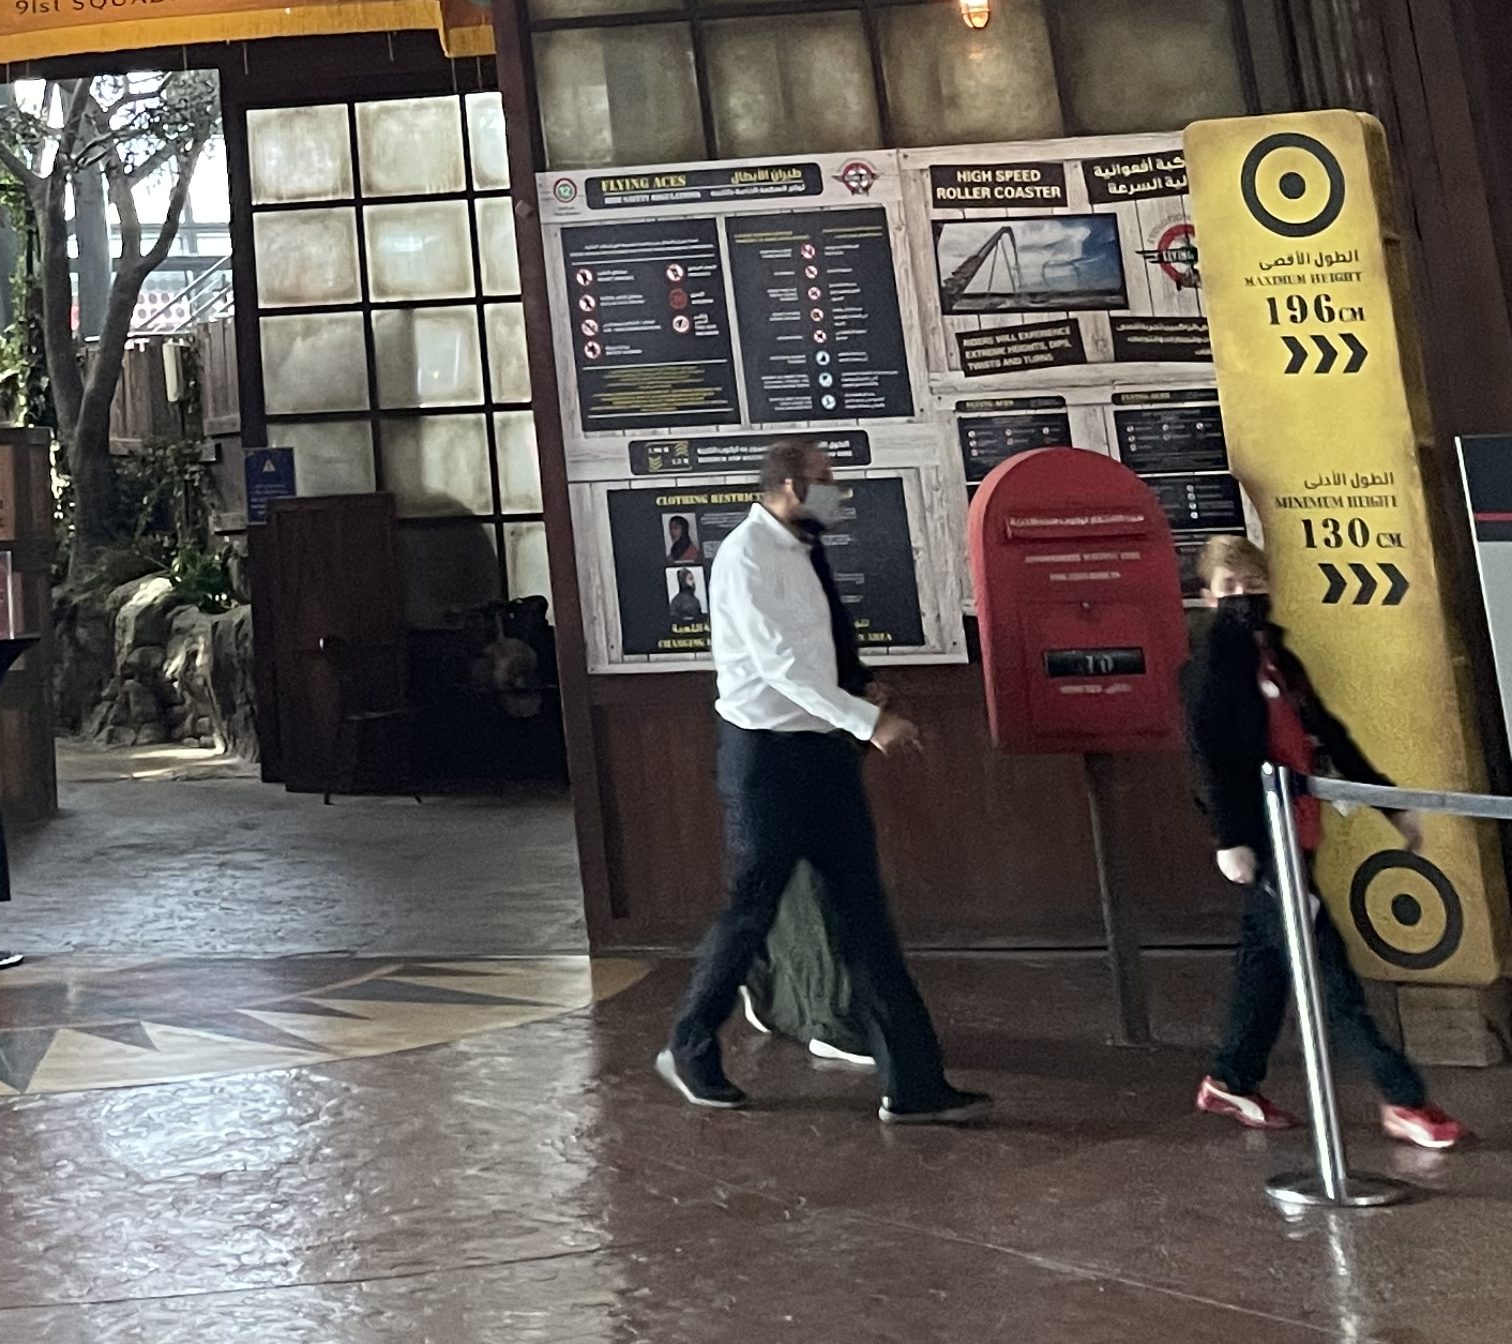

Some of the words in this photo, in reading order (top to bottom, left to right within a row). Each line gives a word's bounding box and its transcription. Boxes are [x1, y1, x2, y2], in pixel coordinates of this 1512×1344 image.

[601, 177, 649, 192] FLYING
[653, 175, 686, 188] ACES
[957, 169, 992, 182] HIGH
[995, 168, 1041, 182] SPEED
[936, 186, 990, 200] ROLLER
[993, 185, 1061, 199] COASTER
[1108, 177, 1163, 195] السرعة
[1259, 250, 1311, 271] الأقصى
[1314, 249, 1359, 267] الطول
[1245, 274, 1306, 287] MAXIMUM
[1310, 271, 1362, 284] HEIGHT
[1266, 293, 1336, 325] 196
[1338, 306, 1366, 323] CM
[1304, 469, 1346, 490] الأدنى
[1350, 472, 1394, 489] الطول
[656, 494, 708, 506] CLOTHING
[1275, 496, 1343, 509] MINIMUM
[1347, 495, 1398, 508] HEIGHT
[1301, 518, 1370, 549] 130
[1375, 533, 1405, 549] CM
